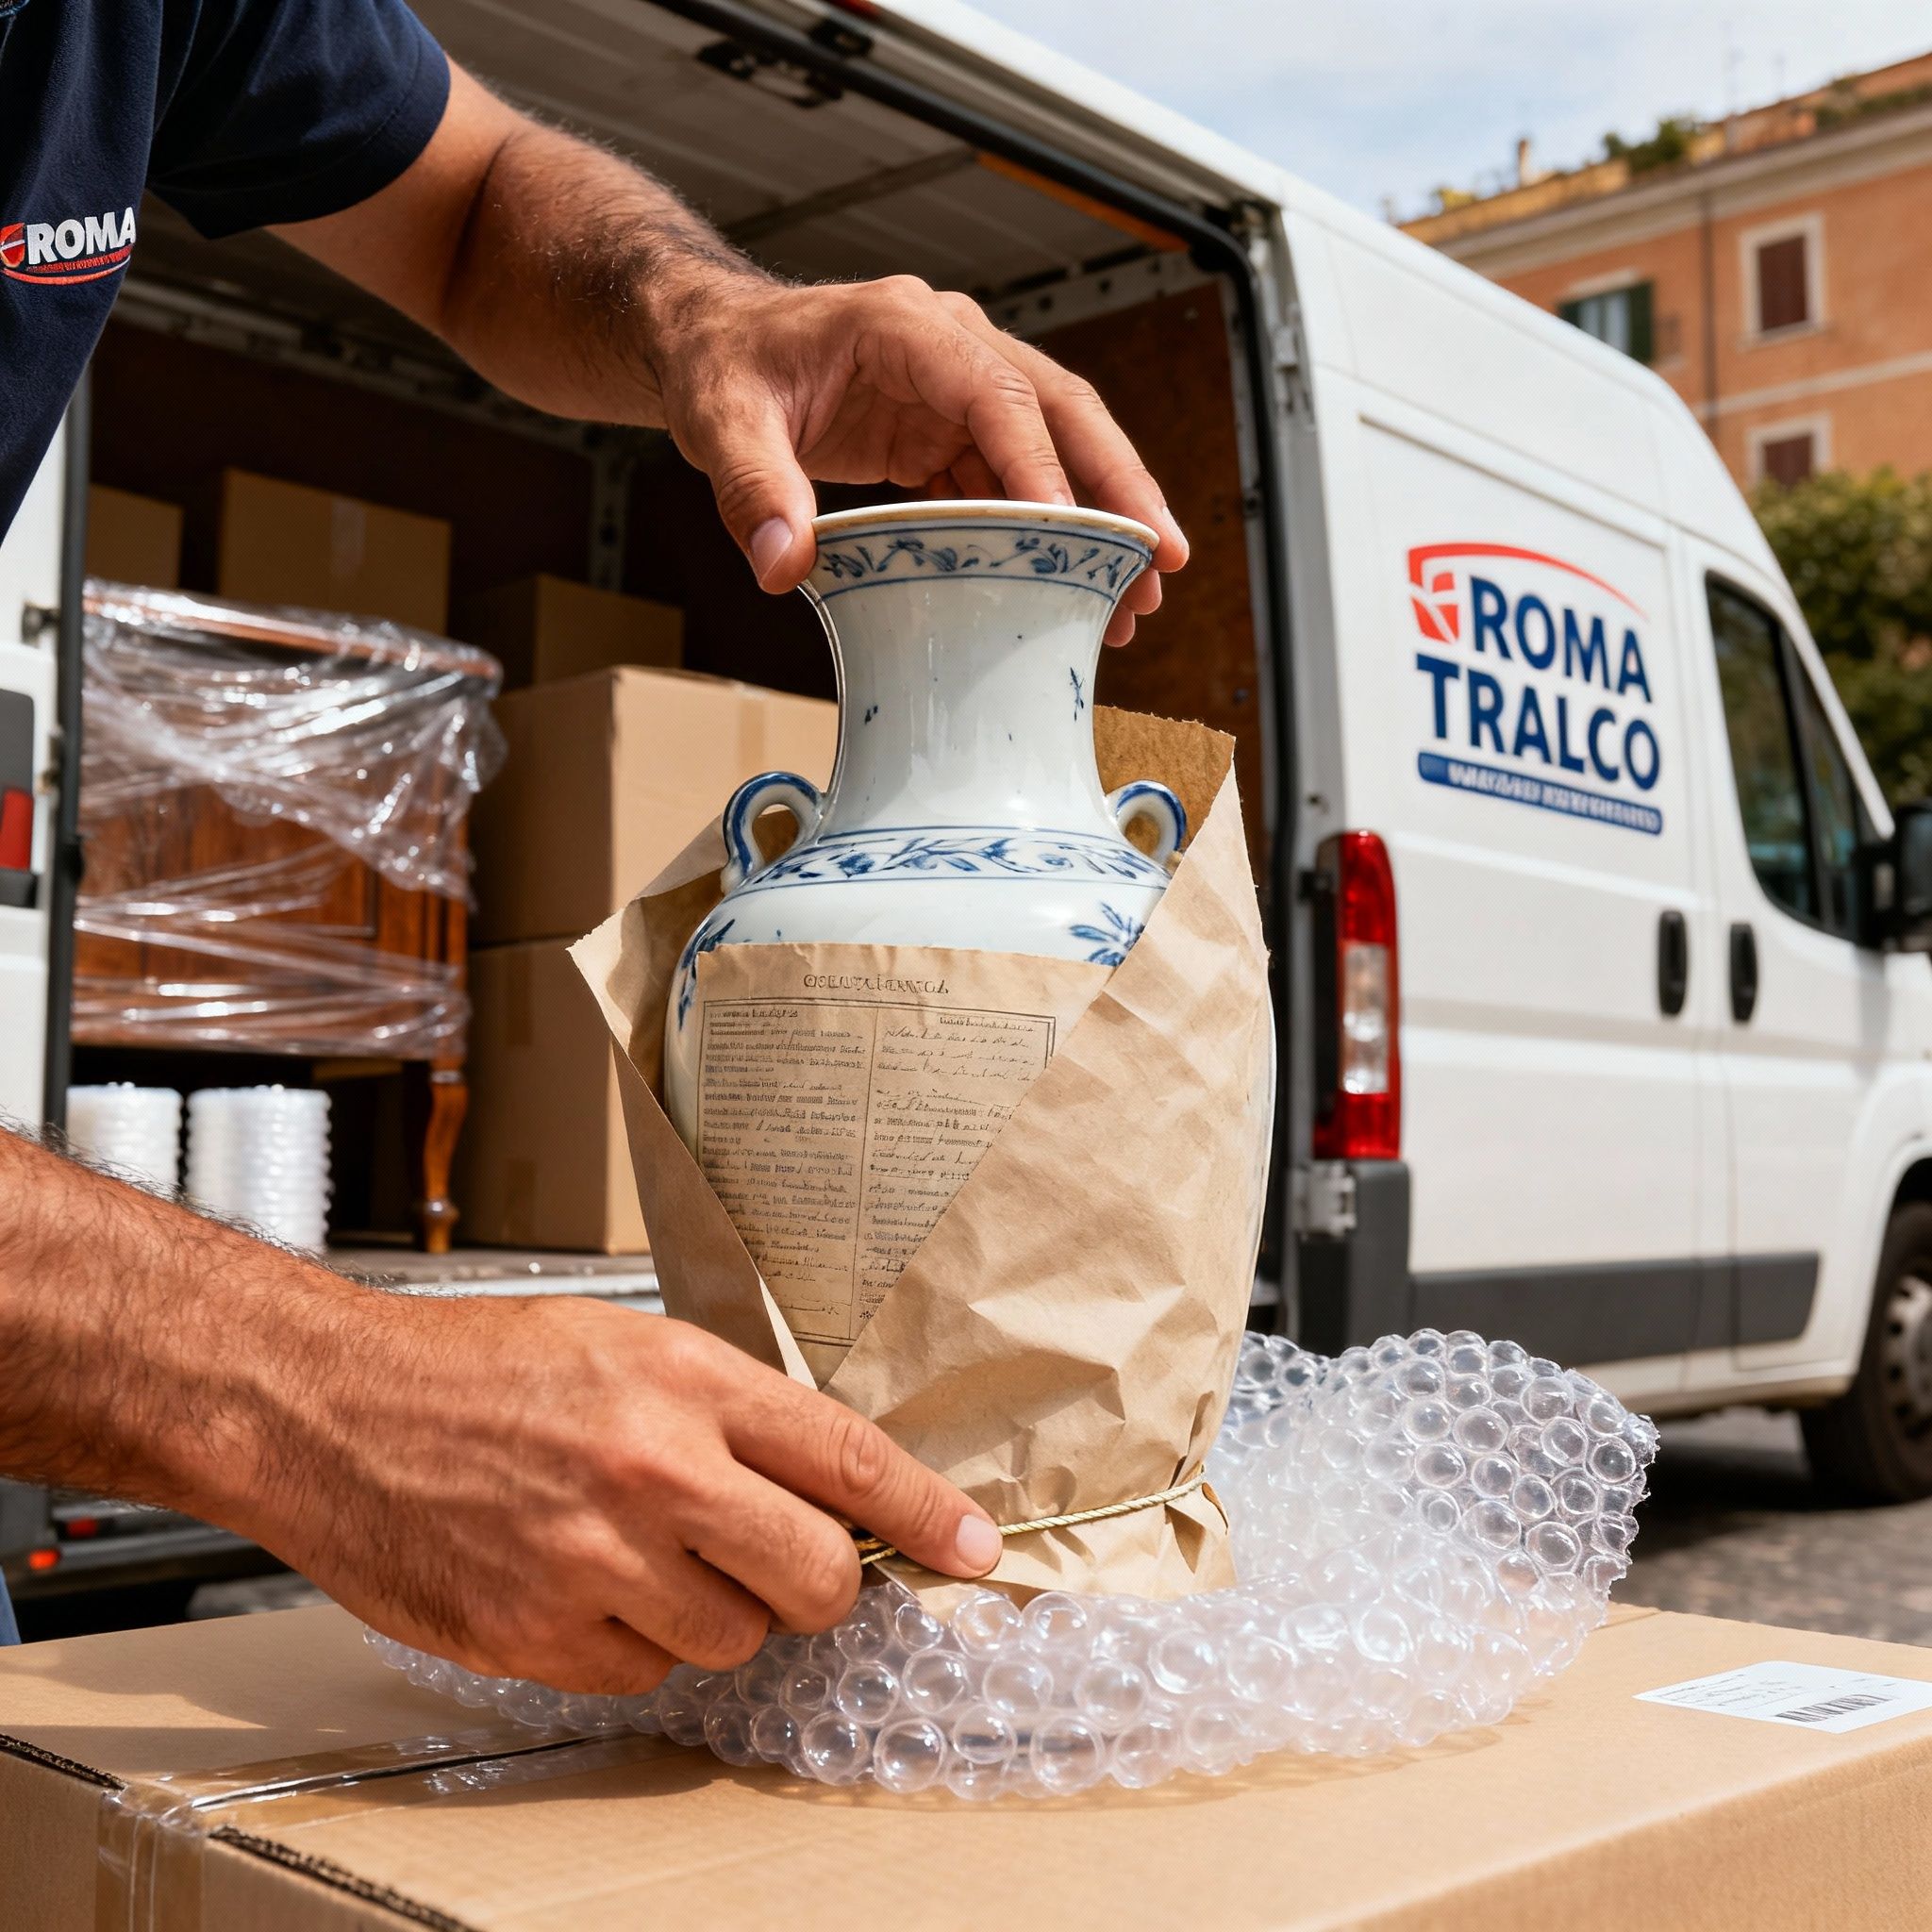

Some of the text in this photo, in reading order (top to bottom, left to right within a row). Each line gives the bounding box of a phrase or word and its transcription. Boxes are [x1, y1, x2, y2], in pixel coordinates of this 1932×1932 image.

[26, 207, 137, 265] ROMA
[1470, 575, 1653, 704] ROMA
[1416, 653, 1660, 791] TRALCO
